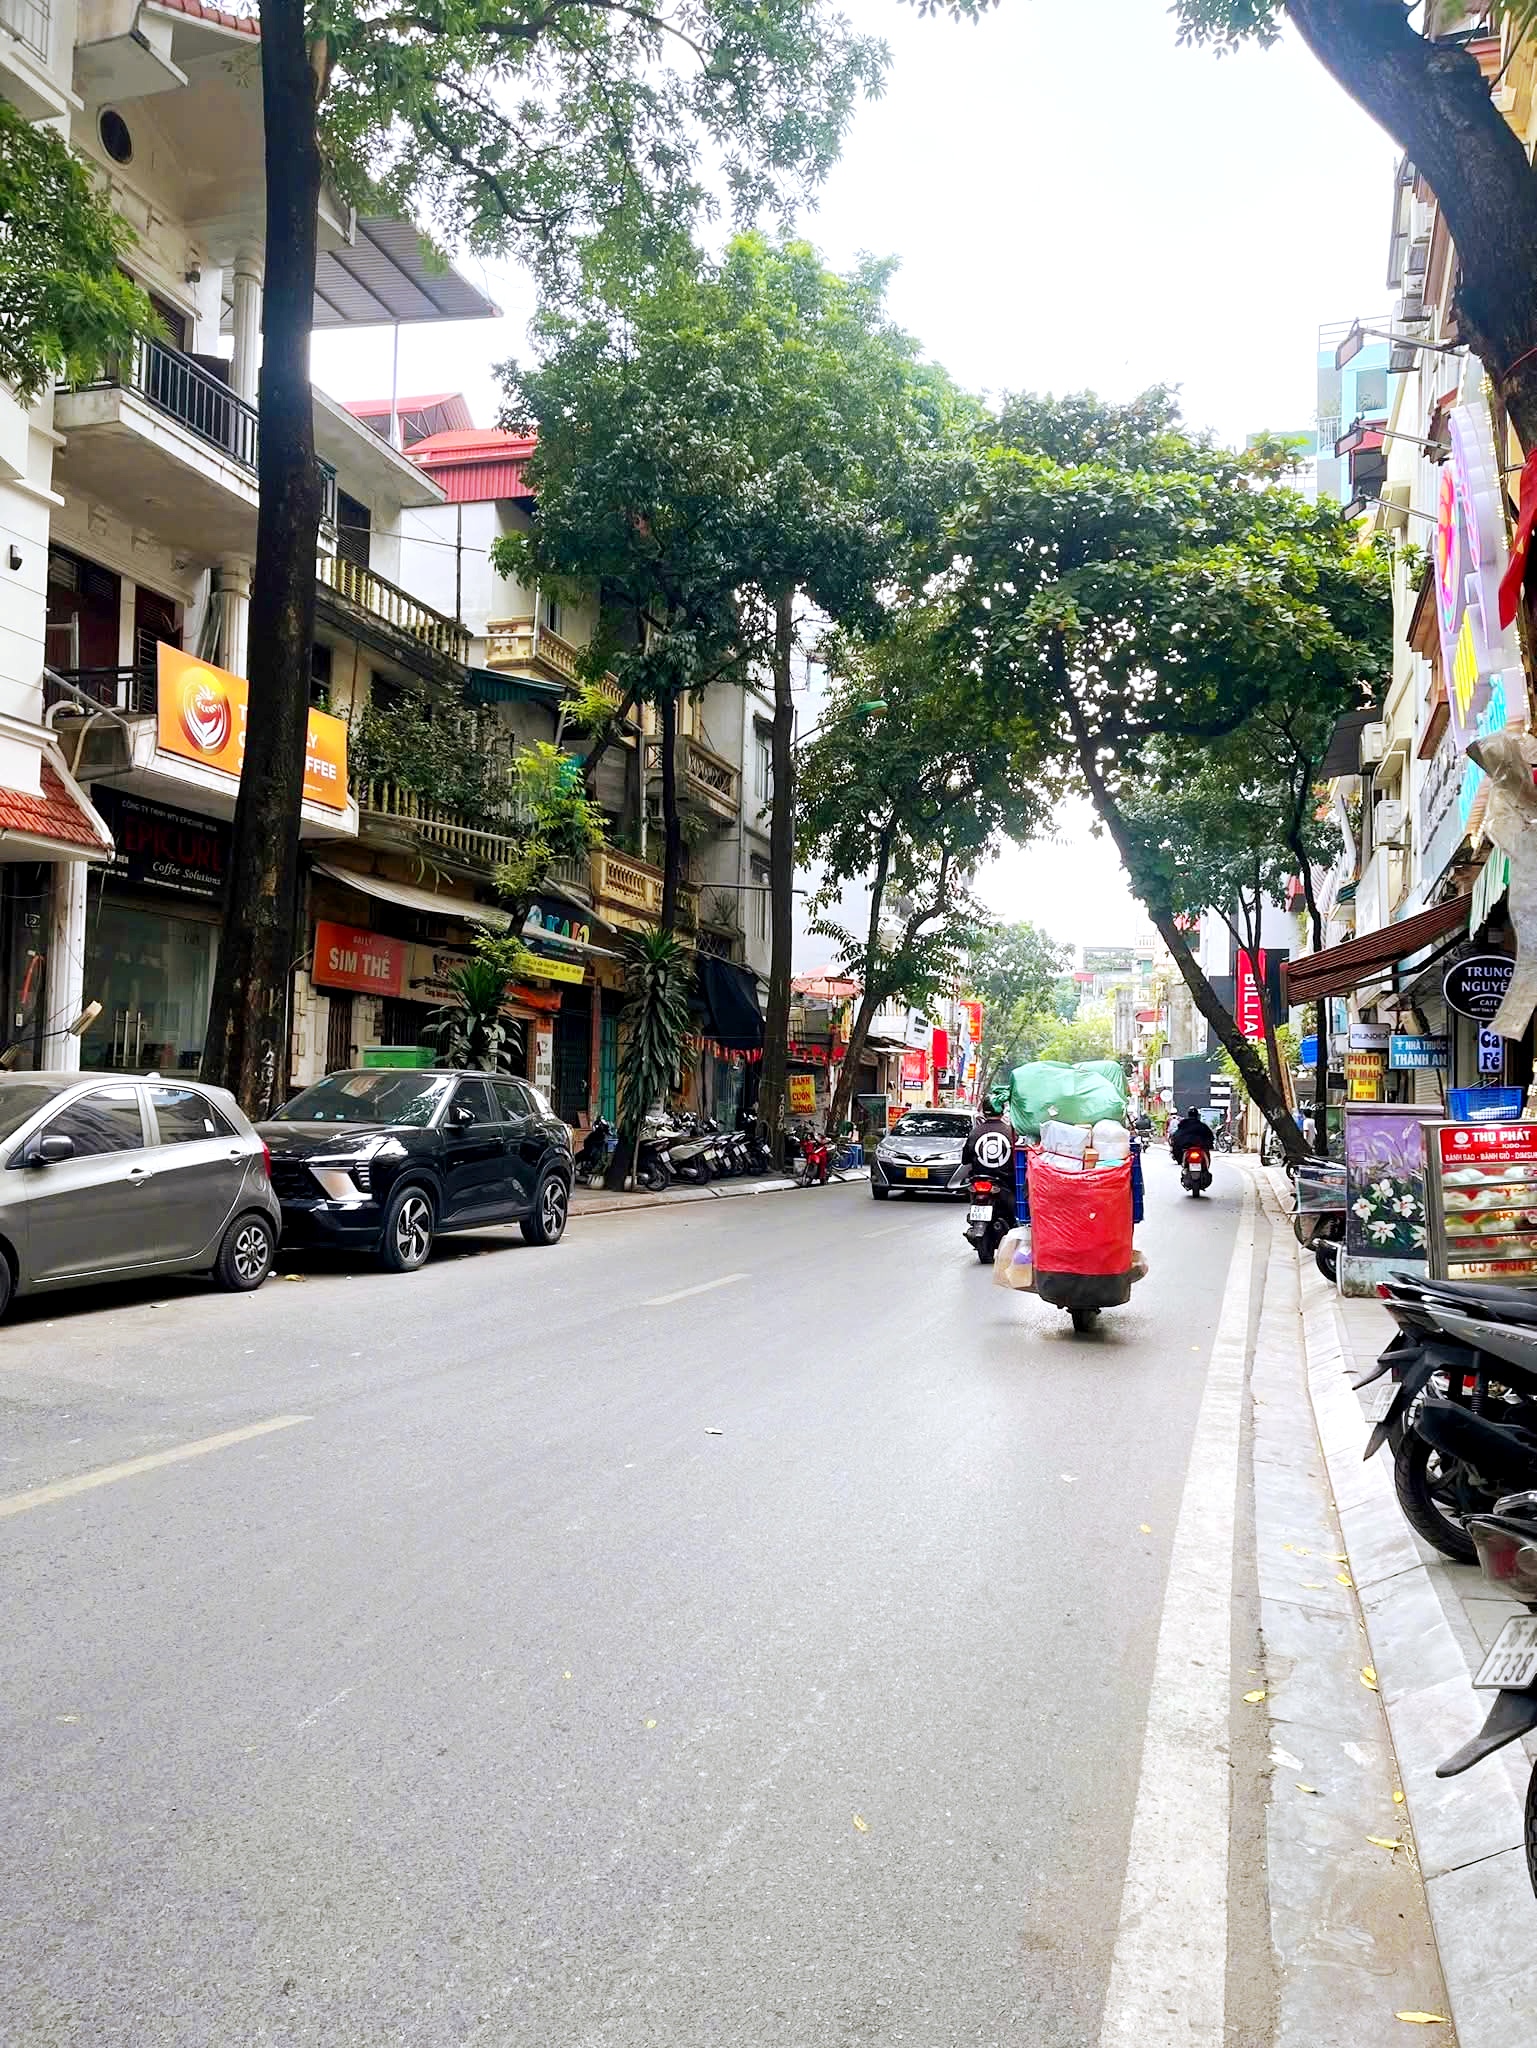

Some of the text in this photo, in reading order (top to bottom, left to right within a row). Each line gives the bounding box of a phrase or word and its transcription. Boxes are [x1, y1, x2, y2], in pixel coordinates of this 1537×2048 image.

[152, 861, 221, 885] Coffee Solutions
[328, 946, 359, 974] SIM
[1465, 966, 1513, 978] TRUNG
[1480, 1031, 1500, 1049] Ca
[1348, 1055, 1380, 1066] PHOTO
[1395, 1052, 1448, 1066] THÀNH AN
[1481, 1052, 1500, 1070] Fé
[1472, 1128, 1530, 1144] THỌ PHÁT
[1481, 1651, 1535, 1683] 7338
